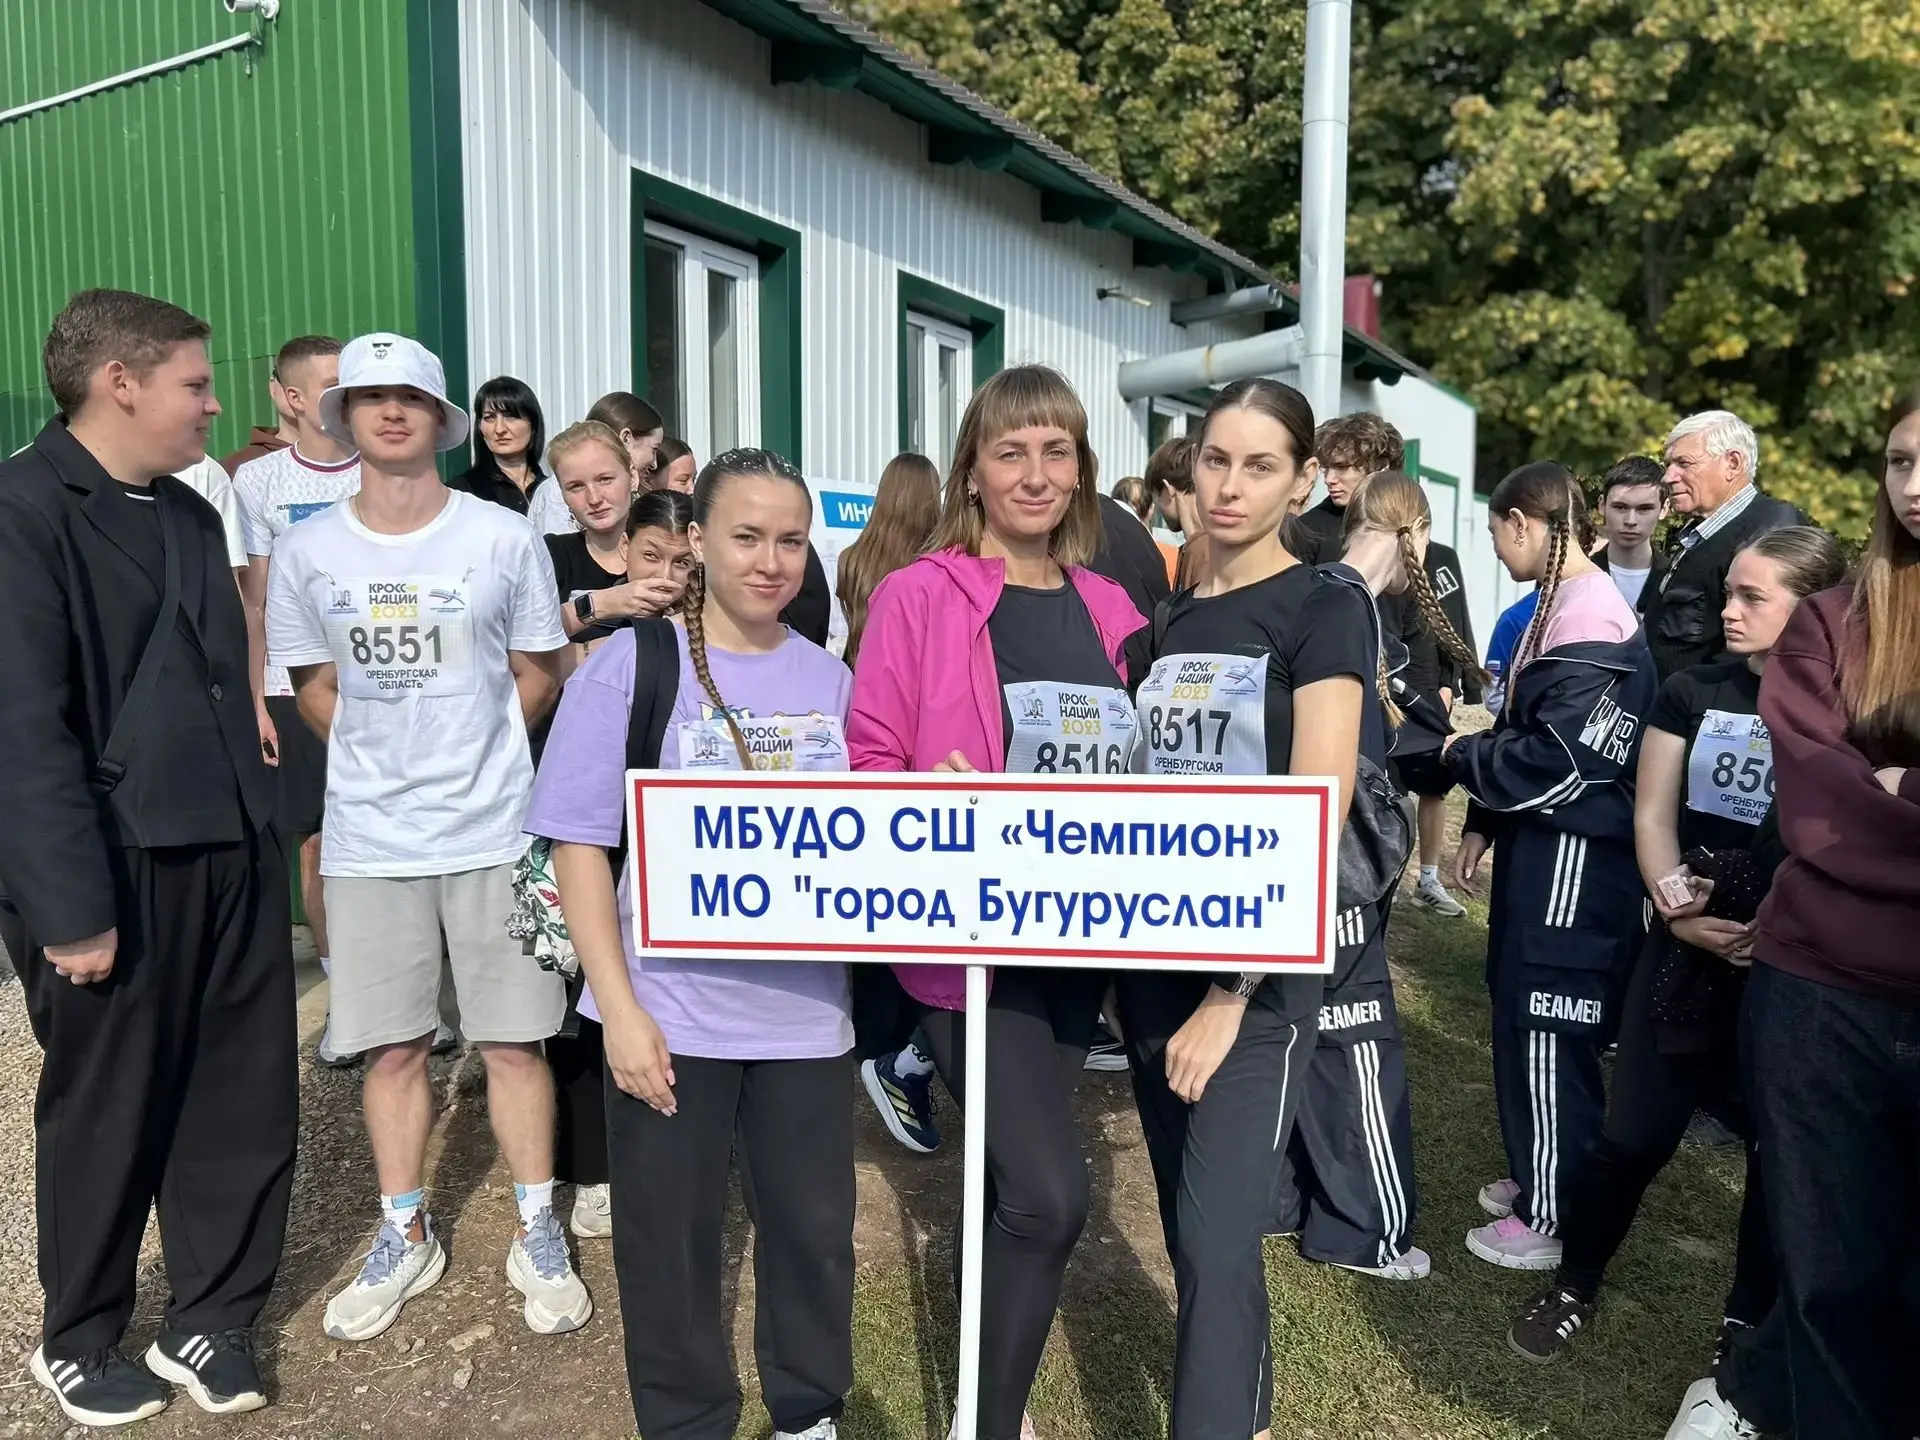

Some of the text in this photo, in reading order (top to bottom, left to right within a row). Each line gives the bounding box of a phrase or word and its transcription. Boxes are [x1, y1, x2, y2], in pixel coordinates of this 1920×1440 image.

[369, 583, 407, 593] КРОСС
[369, 594, 418, 605] НАЦИИ
[370, 605, 418, 619] 2023
[349, 625, 442, 665] 8551
[1180, 661, 1212, 672] КРОСС
[366, 669, 438, 680] ОРЕНБУРГСКАЯ
[1175, 673, 1215, 684] НАЦИИ
[378, 680, 424, 690] ОБЛАСТЬ
[1170, 685, 1210, 700] 2023
[1058, 692, 1089, 706] КРОСС
[1060, 706, 1100, 720] НАЦИИ
[1062, 719, 1101, 735] 2023
[1149, 705, 1232, 756] 8517
[750, 753, 793, 770] 023
[1033, 741, 1121, 774] 8516
[1155, 756, 1223, 773] ОРЕНБУРГСКАЯ
[693, 805, 1280, 859] МБУДО СШ «Чемпион»
[690, 873, 1285, 939] МО "город Бугуруслан"
[1529, 991, 1602, 1024] GEAMER
